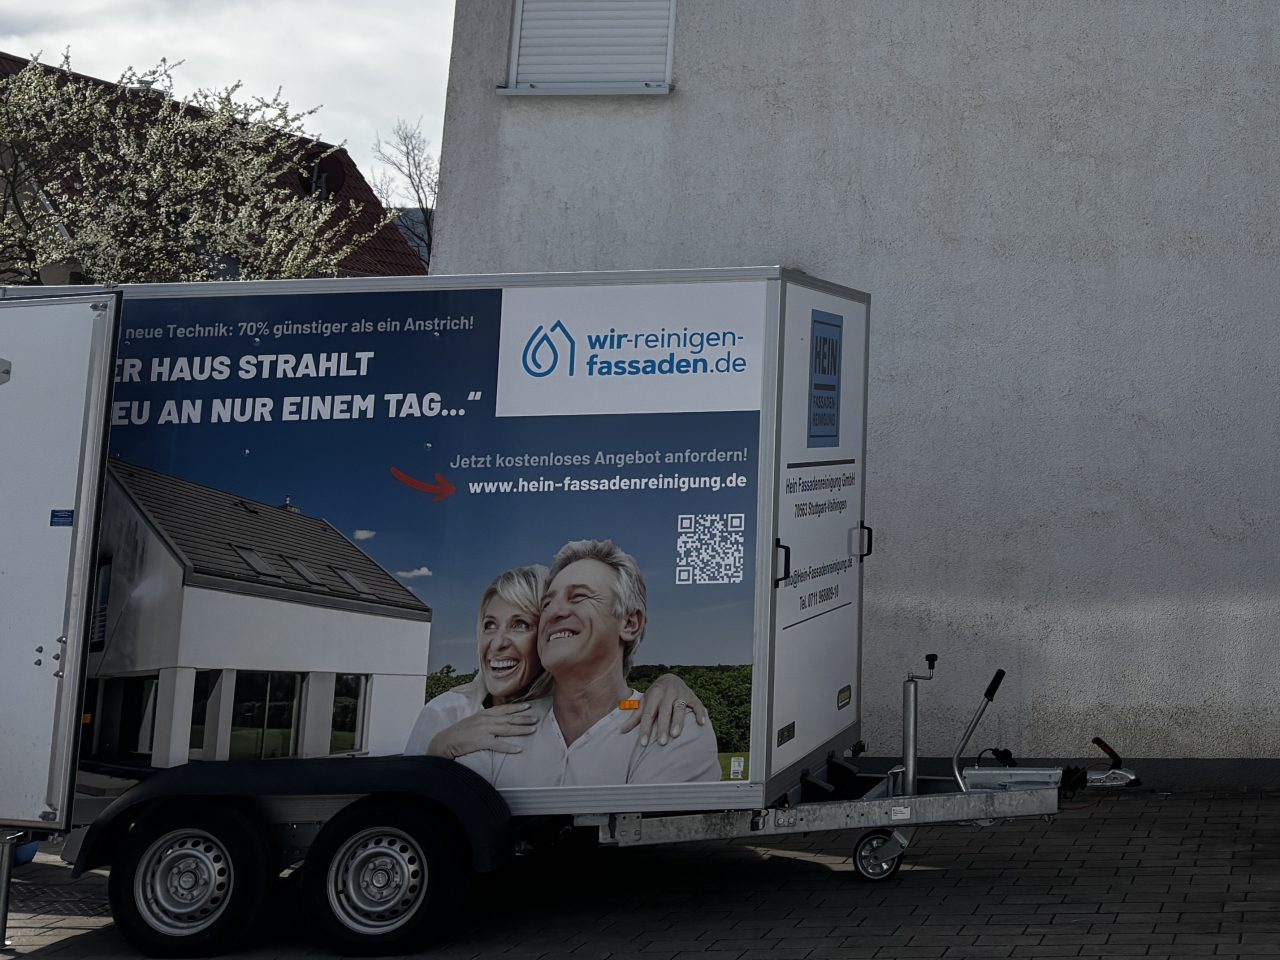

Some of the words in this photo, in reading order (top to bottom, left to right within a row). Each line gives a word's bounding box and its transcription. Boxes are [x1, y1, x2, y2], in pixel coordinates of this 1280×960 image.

[126, 328, 163, 338] neue
[167, 323, 232, 337] Technik:
[238, 322, 269, 335] 70%
[274, 320, 348, 338] günstiger
[351, 319, 373, 332] als
[378, 318, 400, 331] ein
[404, 316, 473, 331] Anstrich!
[587, 328, 743, 356] wir-reinigen-
[151, 356, 230, 381] HAUS
[239, 352, 374, 379] STRAHLT
[586, 352, 746, 376] fassaden.de
[814, 336, 837, 376] HEIN
[158, 400, 202, 424] AN
[211, 398, 273, 422] NUR
[282, 395, 375, 420] EINEM
[450, 455, 491, 468] Jetzt
[496, 452, 590, 467] kostenloses
[594, 451, 661, 467] Angebot
[665, 448, 747, 463] anfordern!
[469, 473, 746, 493] www.hein-fassadenreinigung.de
[785, 477, 798, 495] Hein
[798, 475, 841, 493] Fassadenreinigung
[842, 472, 855, 487] GmbH
[799, 596, 807, 611] Tel.
[808, 590, 818, 608] 0711
